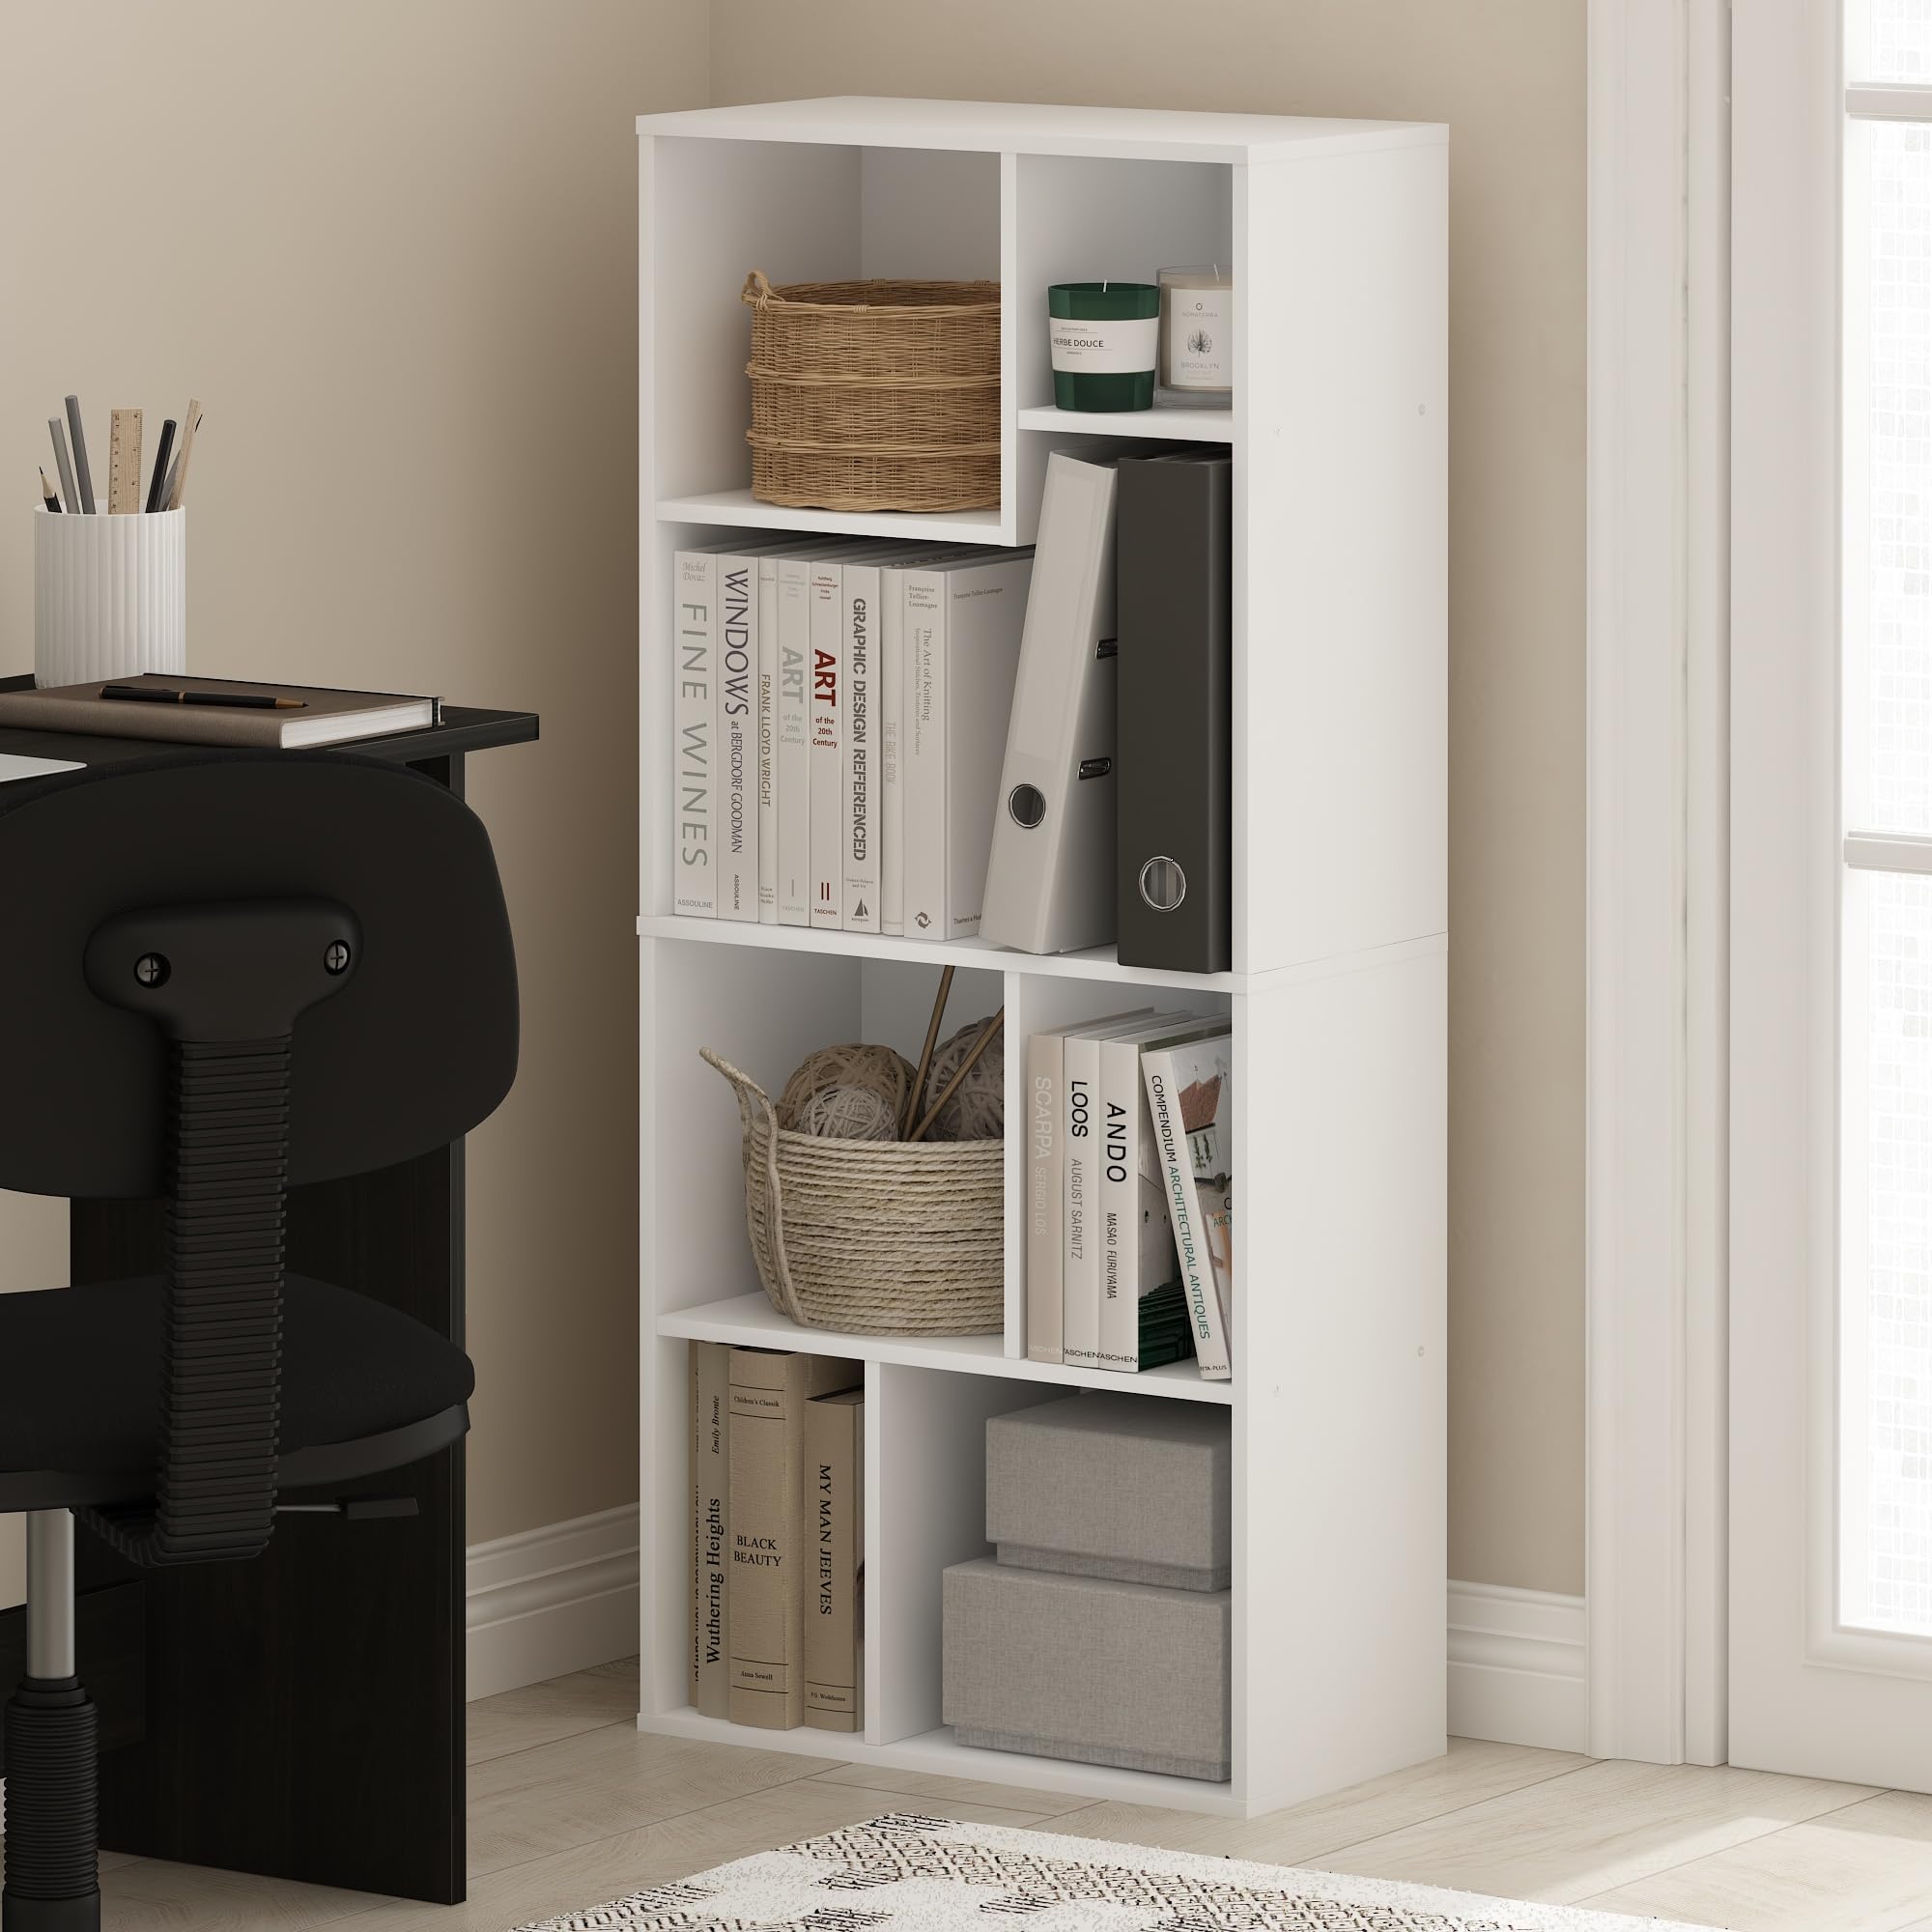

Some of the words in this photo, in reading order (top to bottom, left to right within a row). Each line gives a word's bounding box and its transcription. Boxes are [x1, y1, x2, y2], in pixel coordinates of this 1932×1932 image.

[1073, 339, 1104, 348] DOUCE
[683, 561, 707, 573] Michel
[682, 603, 707, 700] FINE
[724, 567, 749, 716] WINDOWS
[853, 597, 867, 675] GRAPHIC
[923, 628, 932, 647] The
[782, 645, 804, 704] ART
[814, 648, 837, 707] ART
[923, 649, 932, 666] Art
[923, 668, 932, 679] of
[761, 674, 771, 713] FRANK
[853, 680, 867, 743] DESIGN
[921, 680, 932, 722] Knitting
[730, 720, 739, 730] at
[761, 716, 771, 755] LLOYD
[785, 724, 801, 733] 20th
[791, 714, 803, 723] the
[815, 716, 823, 724] of
[824, 717, 835, 725] the
[817, 727, 833, 736] 20th
[730, 731, 743, 791] BERGDORF
[780, 734, 805, 746] Century
[812, 738, 838, 749] Century
[682, 722, 708, 867] WINES
[761, 758, 771, 808] WRIGHT
[730, 792, 743, 854] GOODMAN
[853, 748, 867, 862] REFERENCED
[676, 898, 714, 910] ASSOULINE
[1035, 1075, 1052, 1160] SCARPA
[1071, 1080, 1089, 1138] LOOS
[1106, 1101, 1127, 1182] ANDO
[1070, 1158, 1083, 1208] AUGUST
[1151, 1075, 1178, 1162] COMPENDIUM
[1168, 1166, 1197, 1270] ARCHITECTURAL
[1189, 1274, 1210, 1340] ANTIQUES
[1070, 1208, 1083, 1260] SARNITZ
[1106, 1212, 1118, 1246] MASAO
[1106, 1250, 1118, 1299] FURUYAMA
[711, 1395, 720, 1426] Bronte
[711, 1428, 722, 1455] Emily
[819, 1464, 832, 1495] MY
[706, 1498, 724, 1566] Heights
[819, 1498, 832, 1544] MAN
[733, 1550, 781, 1567] BEAUTY
[736, 1535, 778, 1550] BLACK
[819, 1548, 832, 1615] JEEVES
[706, 1572, 724, 1664] Wuthering
[754, 1672, 773, 1681] Sewell
